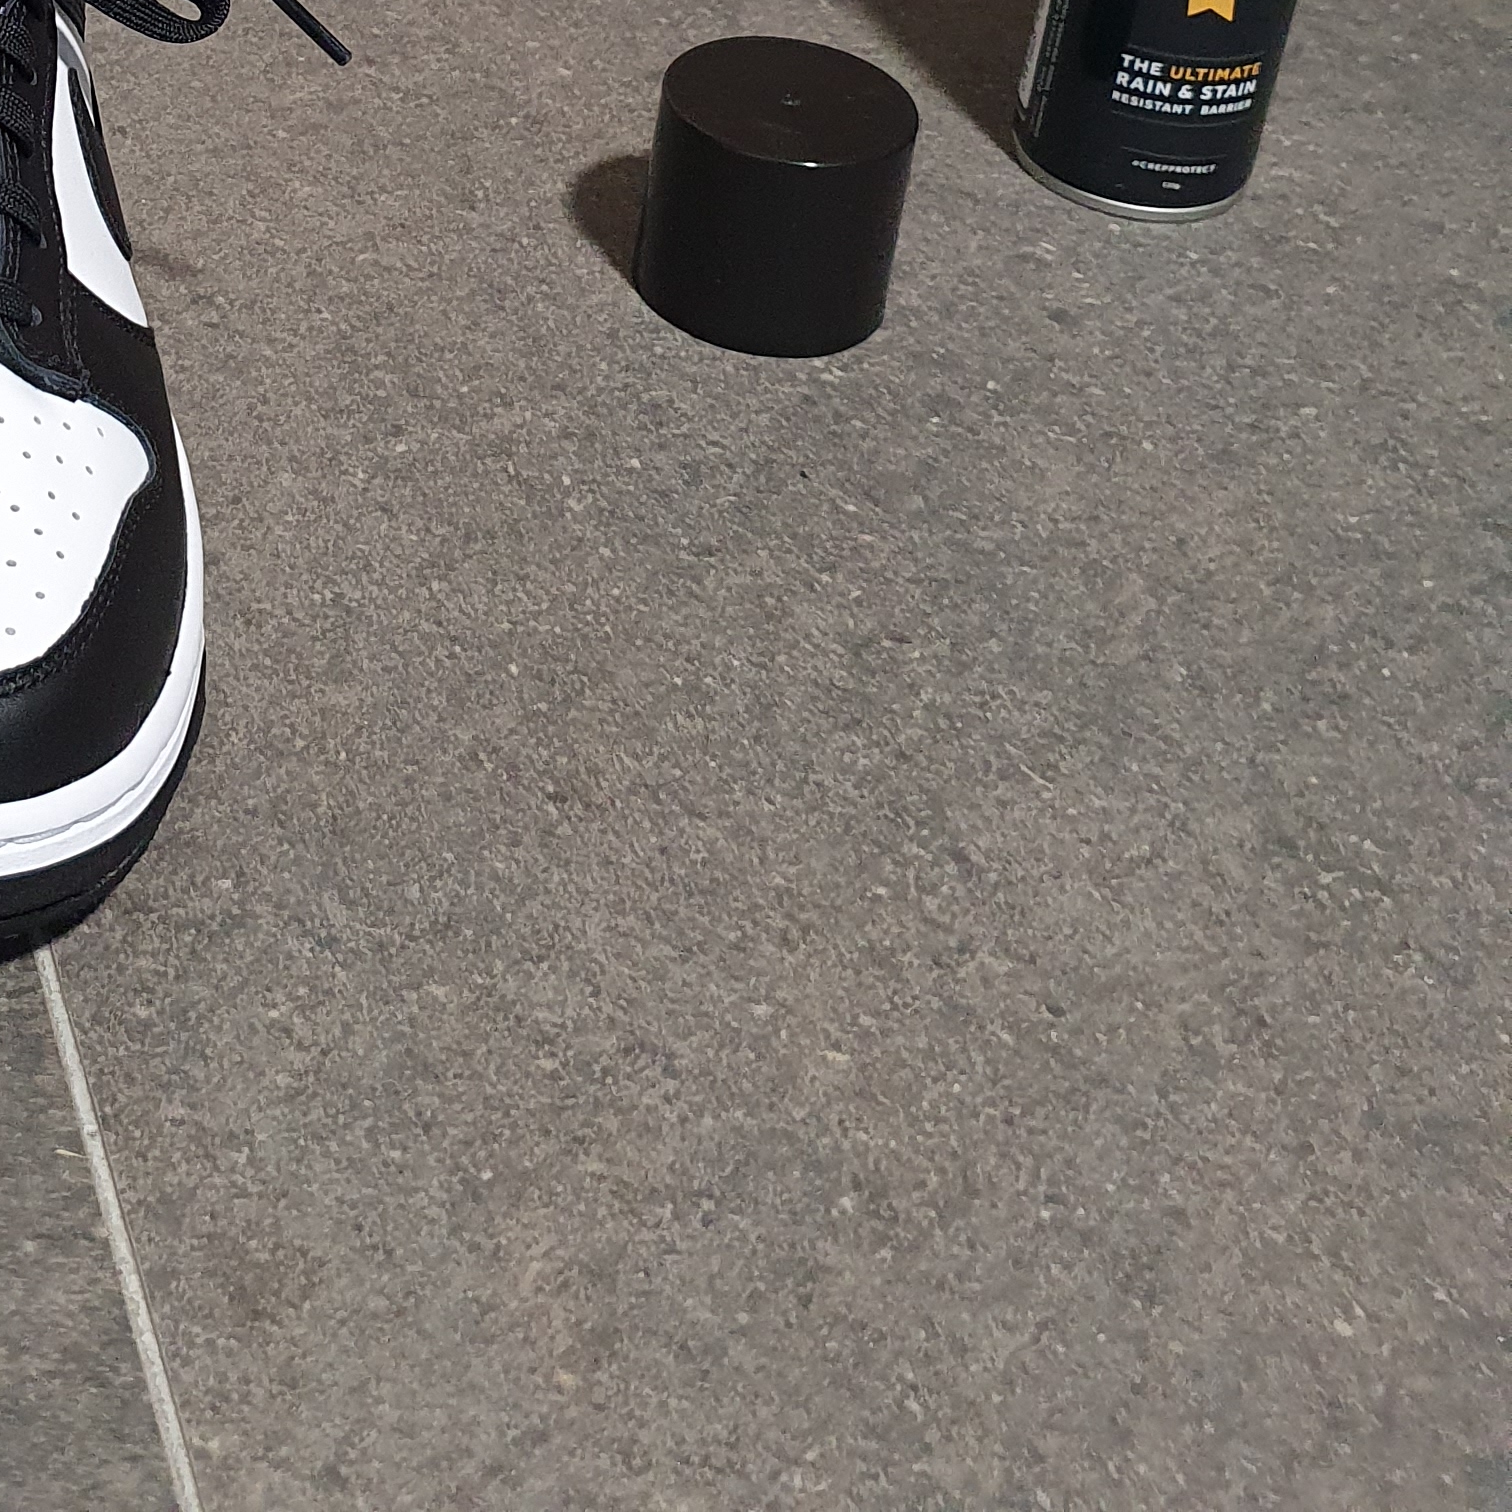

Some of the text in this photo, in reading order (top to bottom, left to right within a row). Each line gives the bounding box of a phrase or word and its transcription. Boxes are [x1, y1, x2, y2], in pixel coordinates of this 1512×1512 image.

[1121, 53, 1262, 81] THE ULTIMATE
[1115, 71, 1257, 100] RAIN & STAIN
[1111, 89, 1253, 116] RESISTANT BARRIER
